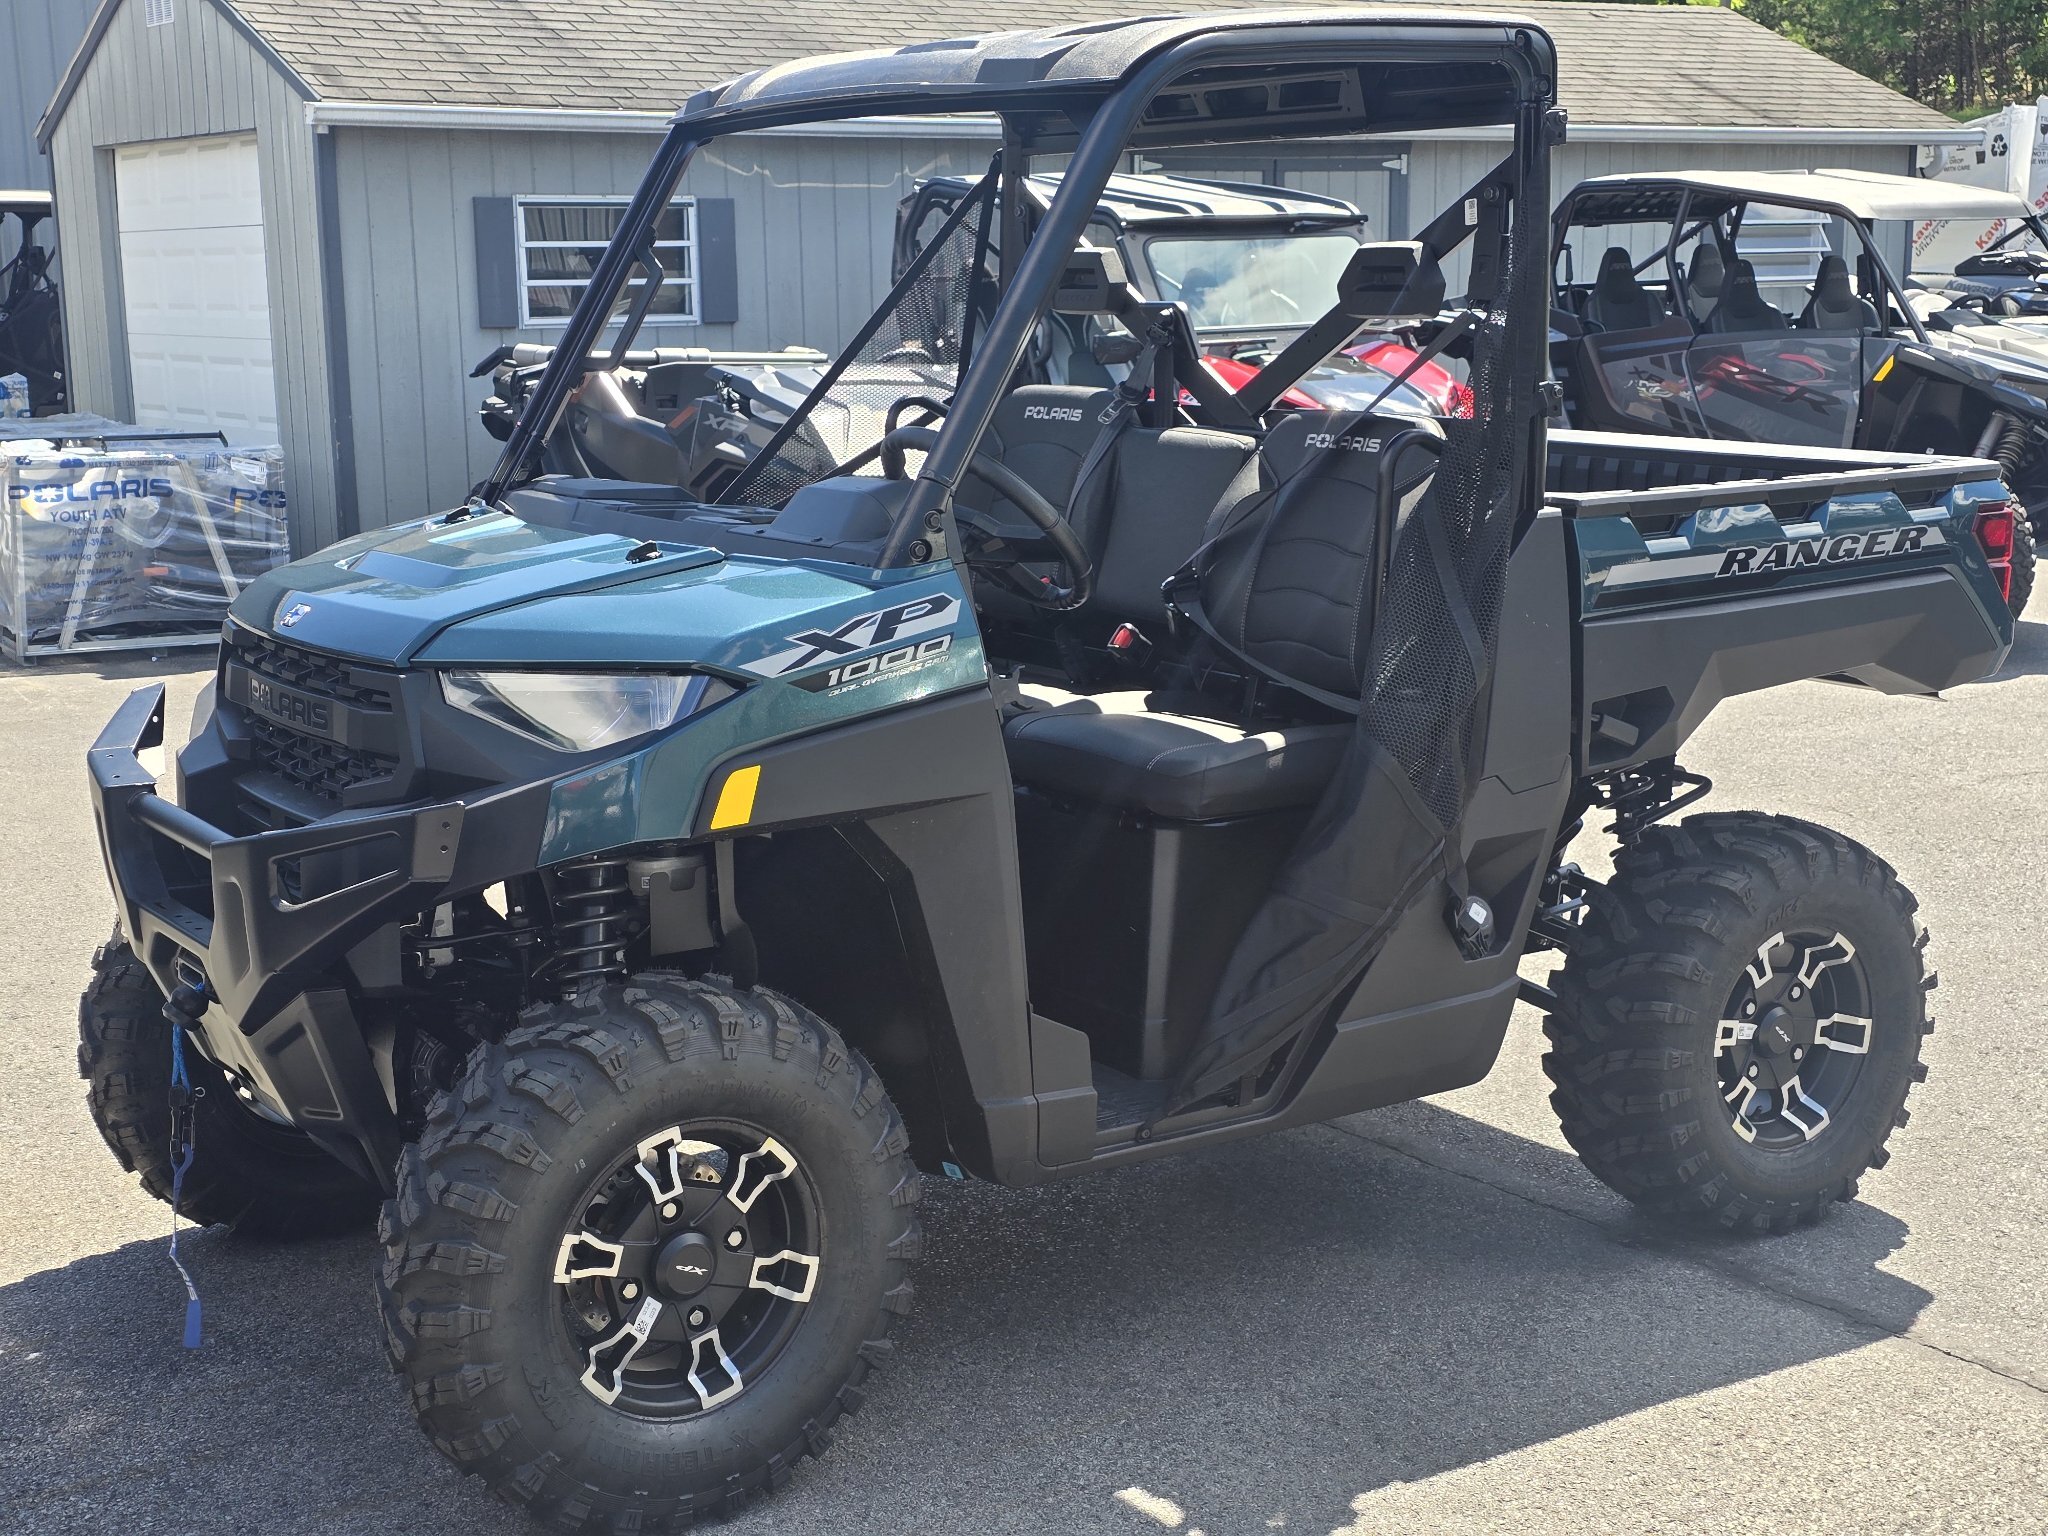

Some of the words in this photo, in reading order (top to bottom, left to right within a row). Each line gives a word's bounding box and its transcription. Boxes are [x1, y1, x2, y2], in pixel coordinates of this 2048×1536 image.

[1024, 406, 1083, 421] POLARIS
[1304, 433, 1382, 453] POLARIS
[8, 479, 174, 503] POLARIS
[50, 510, 97, 522] YOUTH
[103, 507, 127, 520] ATV
[1715, 525, 1930, 578] RANGER
[777, 593, 956, 675] XP
[829, 634, 952, 687] 1000
[251, 677, 331, 733] POLARIS
